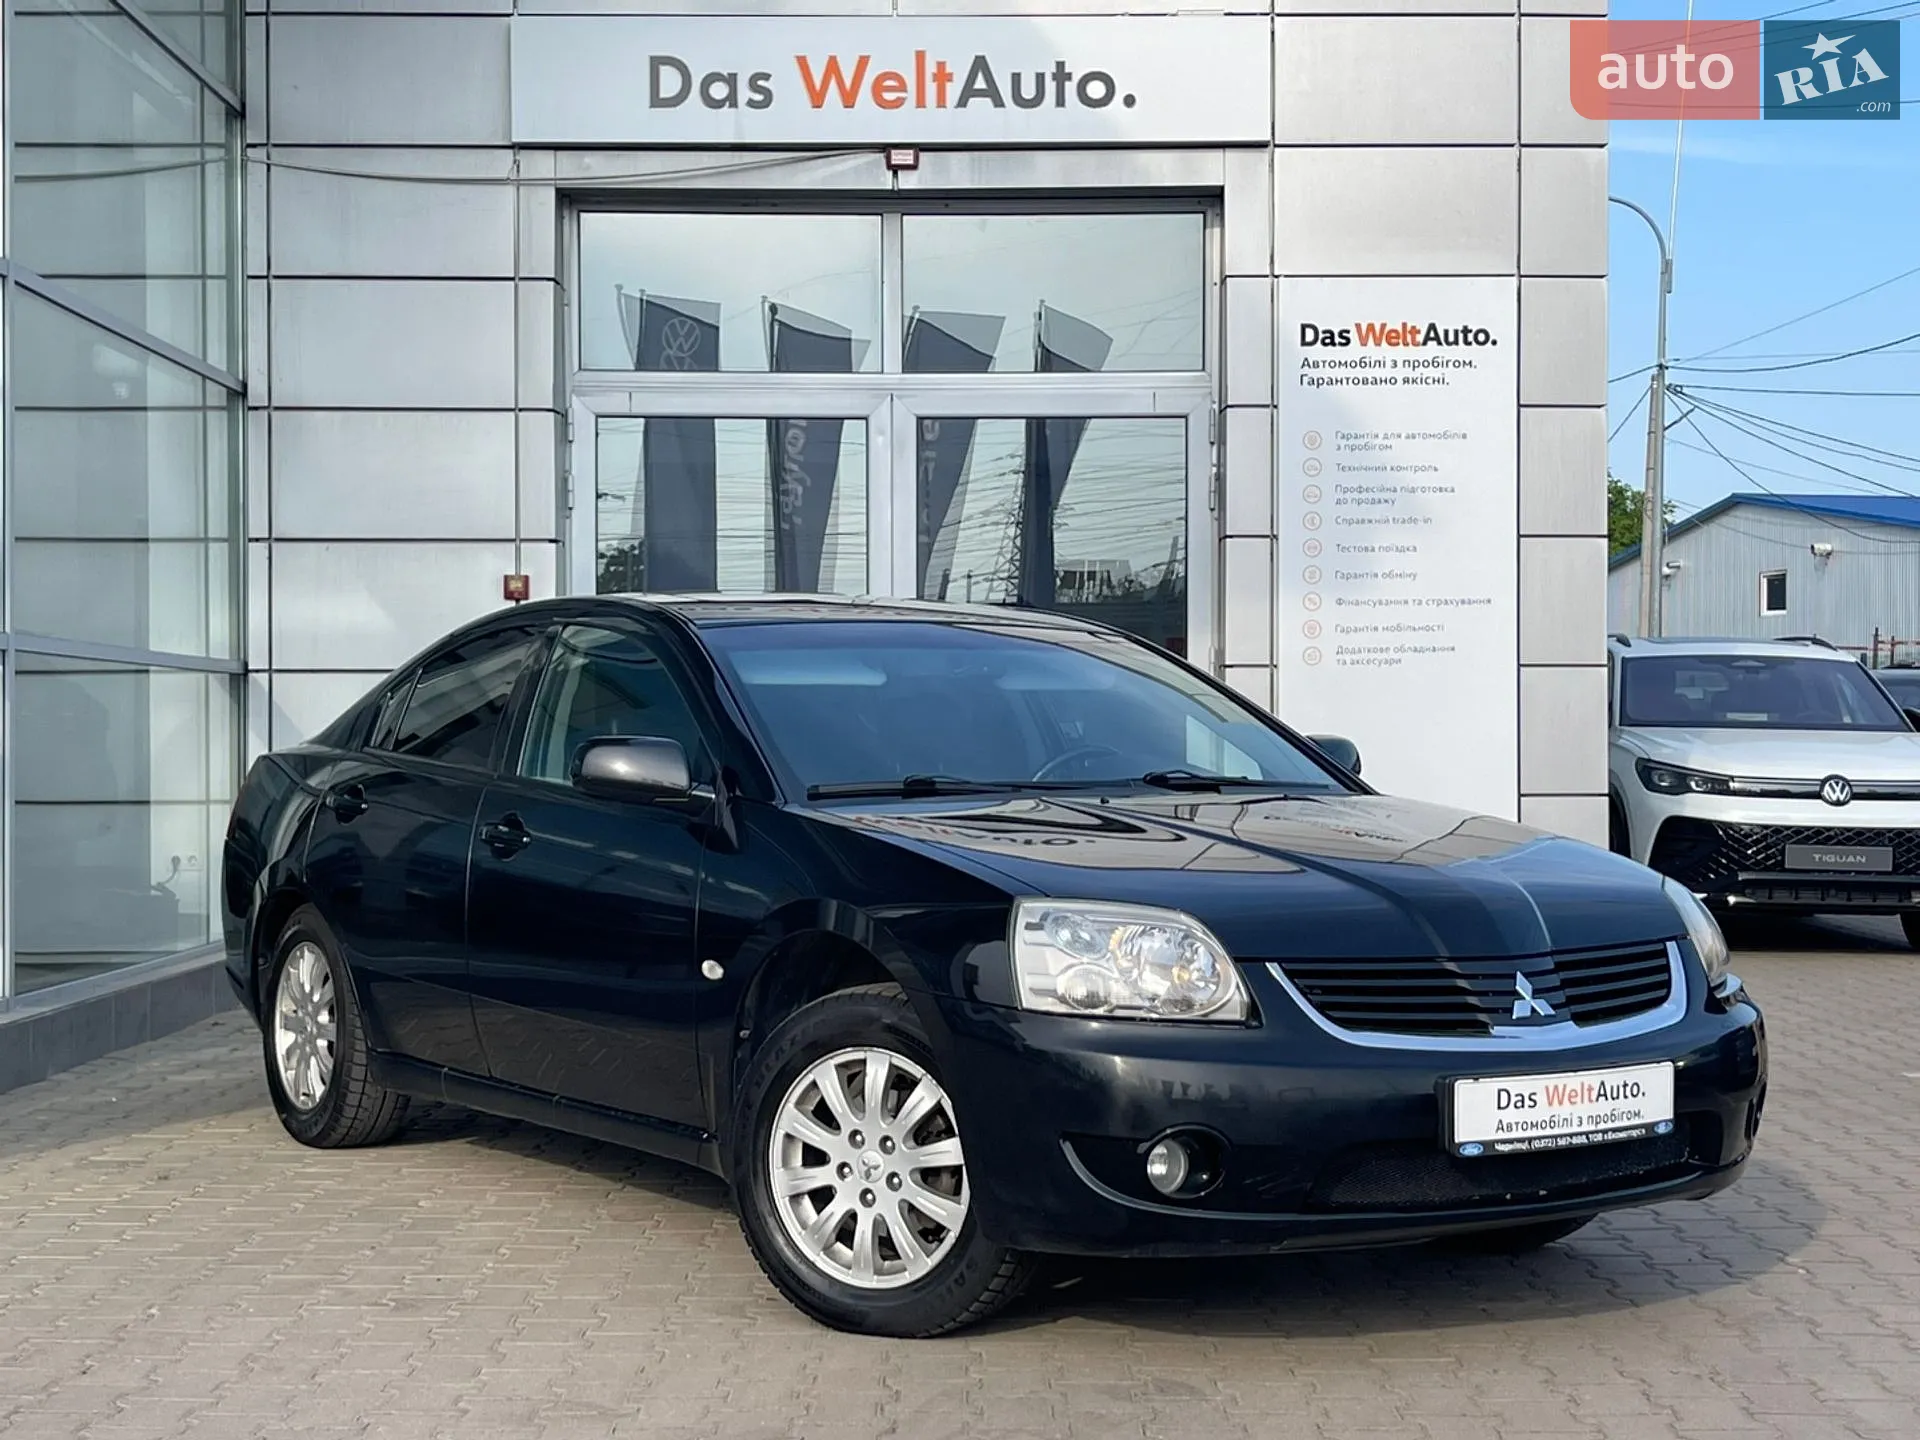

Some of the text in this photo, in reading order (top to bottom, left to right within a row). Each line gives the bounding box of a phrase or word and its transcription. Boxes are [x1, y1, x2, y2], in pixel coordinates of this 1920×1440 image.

[648, 50, 1136, 110] Das WeltAuto.
[1300, 322, 1498, 348] Das WeltAuto.
[1300, 356, 1477, 372] Автомобілі з пробігом.
[1300, 374, 1450, 388] Гарантовано якісні.
[1335, 430, 1468, 442] Гарантія для автомобілів
[1344, 442, 1392, 453] пробігом
[1336, 463, 1438, 474] Технічний контроль
[1334, 484, 1455, 495] Професійна підготовка
[1335, 497, 1396, 507] до продажу
[1335, 515, 1432, 526] Справжній trade-in
[1336, 543, 1417, 553] Тестова поїздка
[1334, 570, 1417, 581] Гарантія обміну
[1336, 597, 1492, 608] Фінансування та страхування
[1334, 622, 1444, 634] Гарантія мобільності
[1336, 644, 1456, 656] Додаткове обладнання
[1336, 658, 1402, 668] та аксесуари
[1812, 853, 1866, 864] TIGUAN
[1496, 1080, 1646, 1110] Das WeltAuto.
[1495, 1113, 1573, 1134] Автомобілі
[1577, 1115, 1583, 1127] з
[1587, 1107, 1644, 1129] пробігом.
